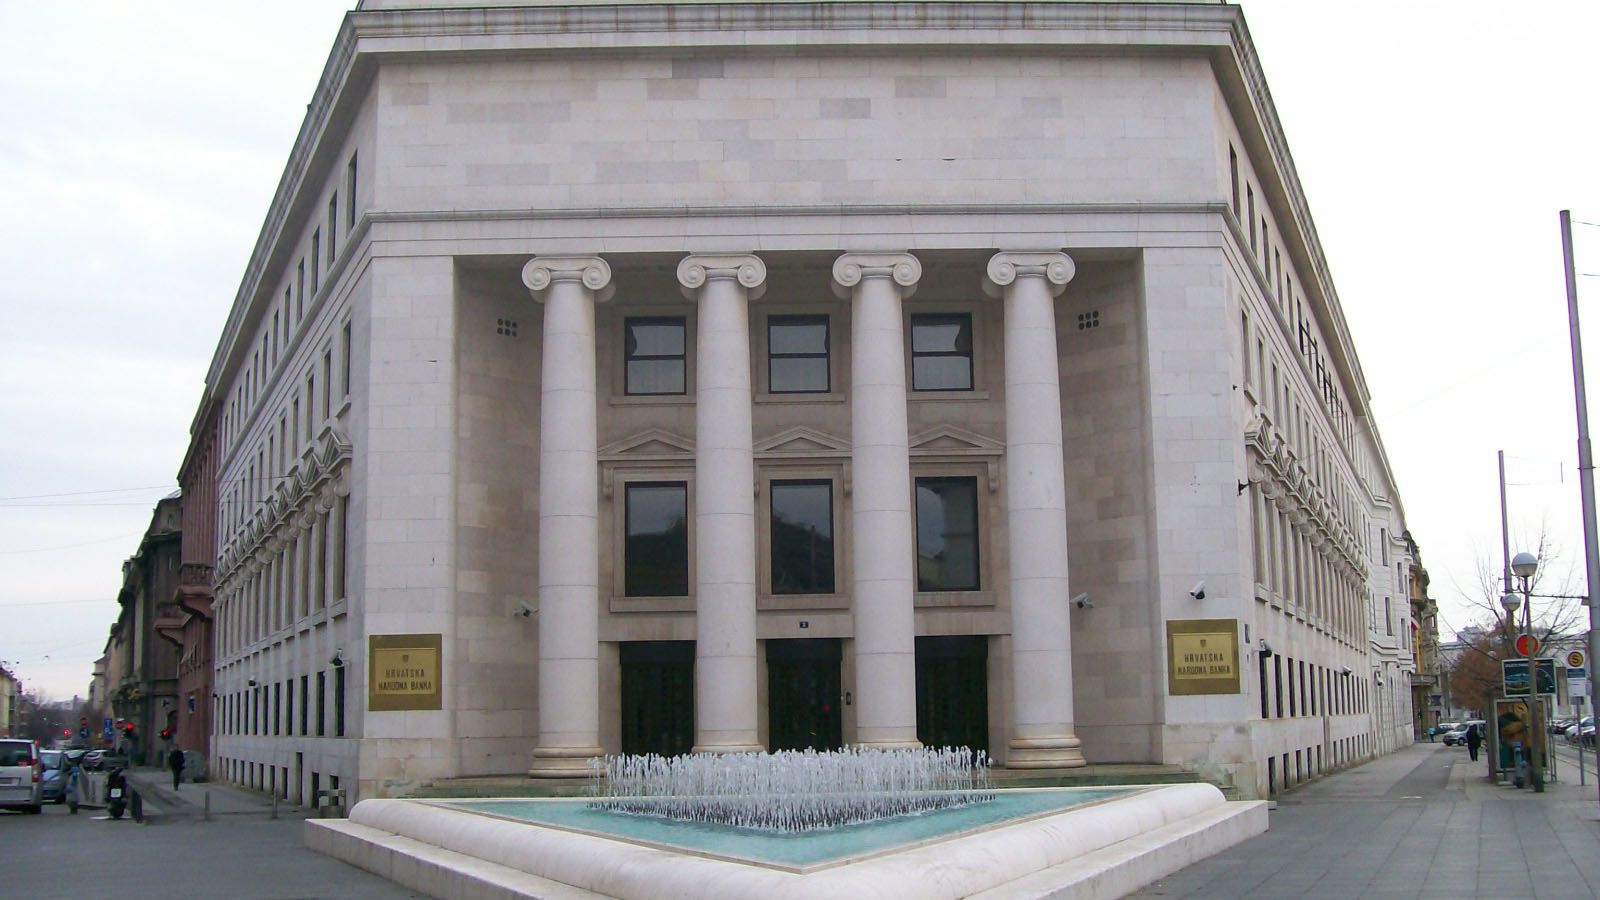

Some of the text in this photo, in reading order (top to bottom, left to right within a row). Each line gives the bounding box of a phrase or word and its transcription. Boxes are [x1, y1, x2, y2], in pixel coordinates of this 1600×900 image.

[1184, 653, 1224, 663] HRVATSKA
[385, 668, 425, 678] HRVATSKA
[1209, 665, 1231, 674] BANKA
[410, 681, 432, 690] BANKA
